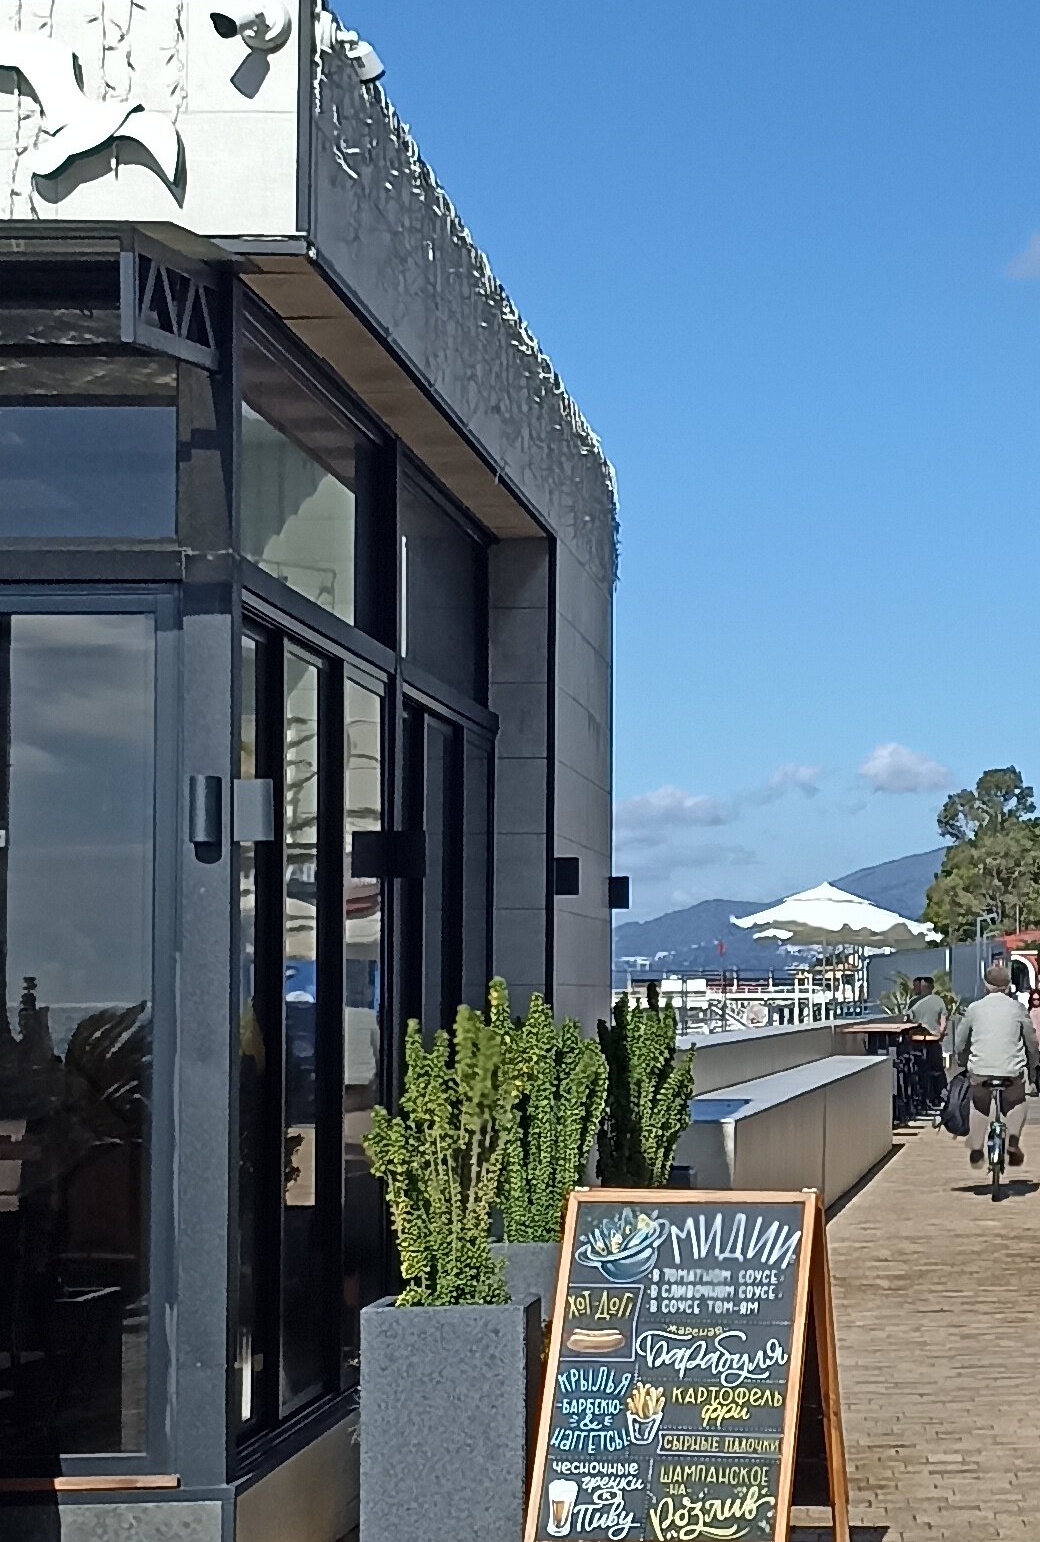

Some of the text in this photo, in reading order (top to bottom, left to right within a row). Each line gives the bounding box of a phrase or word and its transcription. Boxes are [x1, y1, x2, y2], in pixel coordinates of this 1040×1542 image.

[670, 1212, 802, 1270] МИДИИ
[652, 1269, 660, 1283] В
[663, 1267, 732, 1283] ТОМАТНОМ
[650, 1285, 659, 1299] В
[661, 1284, 735, 1299] СЛИВОЧНОМ
[649, 1300, 759, 1315] В СОУСЕ ТОМ-ЯМ
[636, 1330, 789, 1387] Барабуля
[557, 1366, 632, 1397] КРЫЛЬЯ
[672, 1387, 783, 1407] КАРТОФЕЛЬ
[562, 1399, 620, 1415] БАРБЕКЮ
[701, 1400, 751, 1427] фри
[580, 1413, 603, 1430] &
[663, 1435, 780, 1453] СЫРНЫЕ ПАЛОЧКИ
[552, 1461, 640, 1475] чесночные
[659, 1464, 770, 1486] ШАМПАНСКОЕ
[581, 1475, 645, 1493] гренки
[669, 1484, 687, 1495] НА
[573, 1499, 641, 1540] Пиву
[650, 1486, 776, 1541] Розлив
